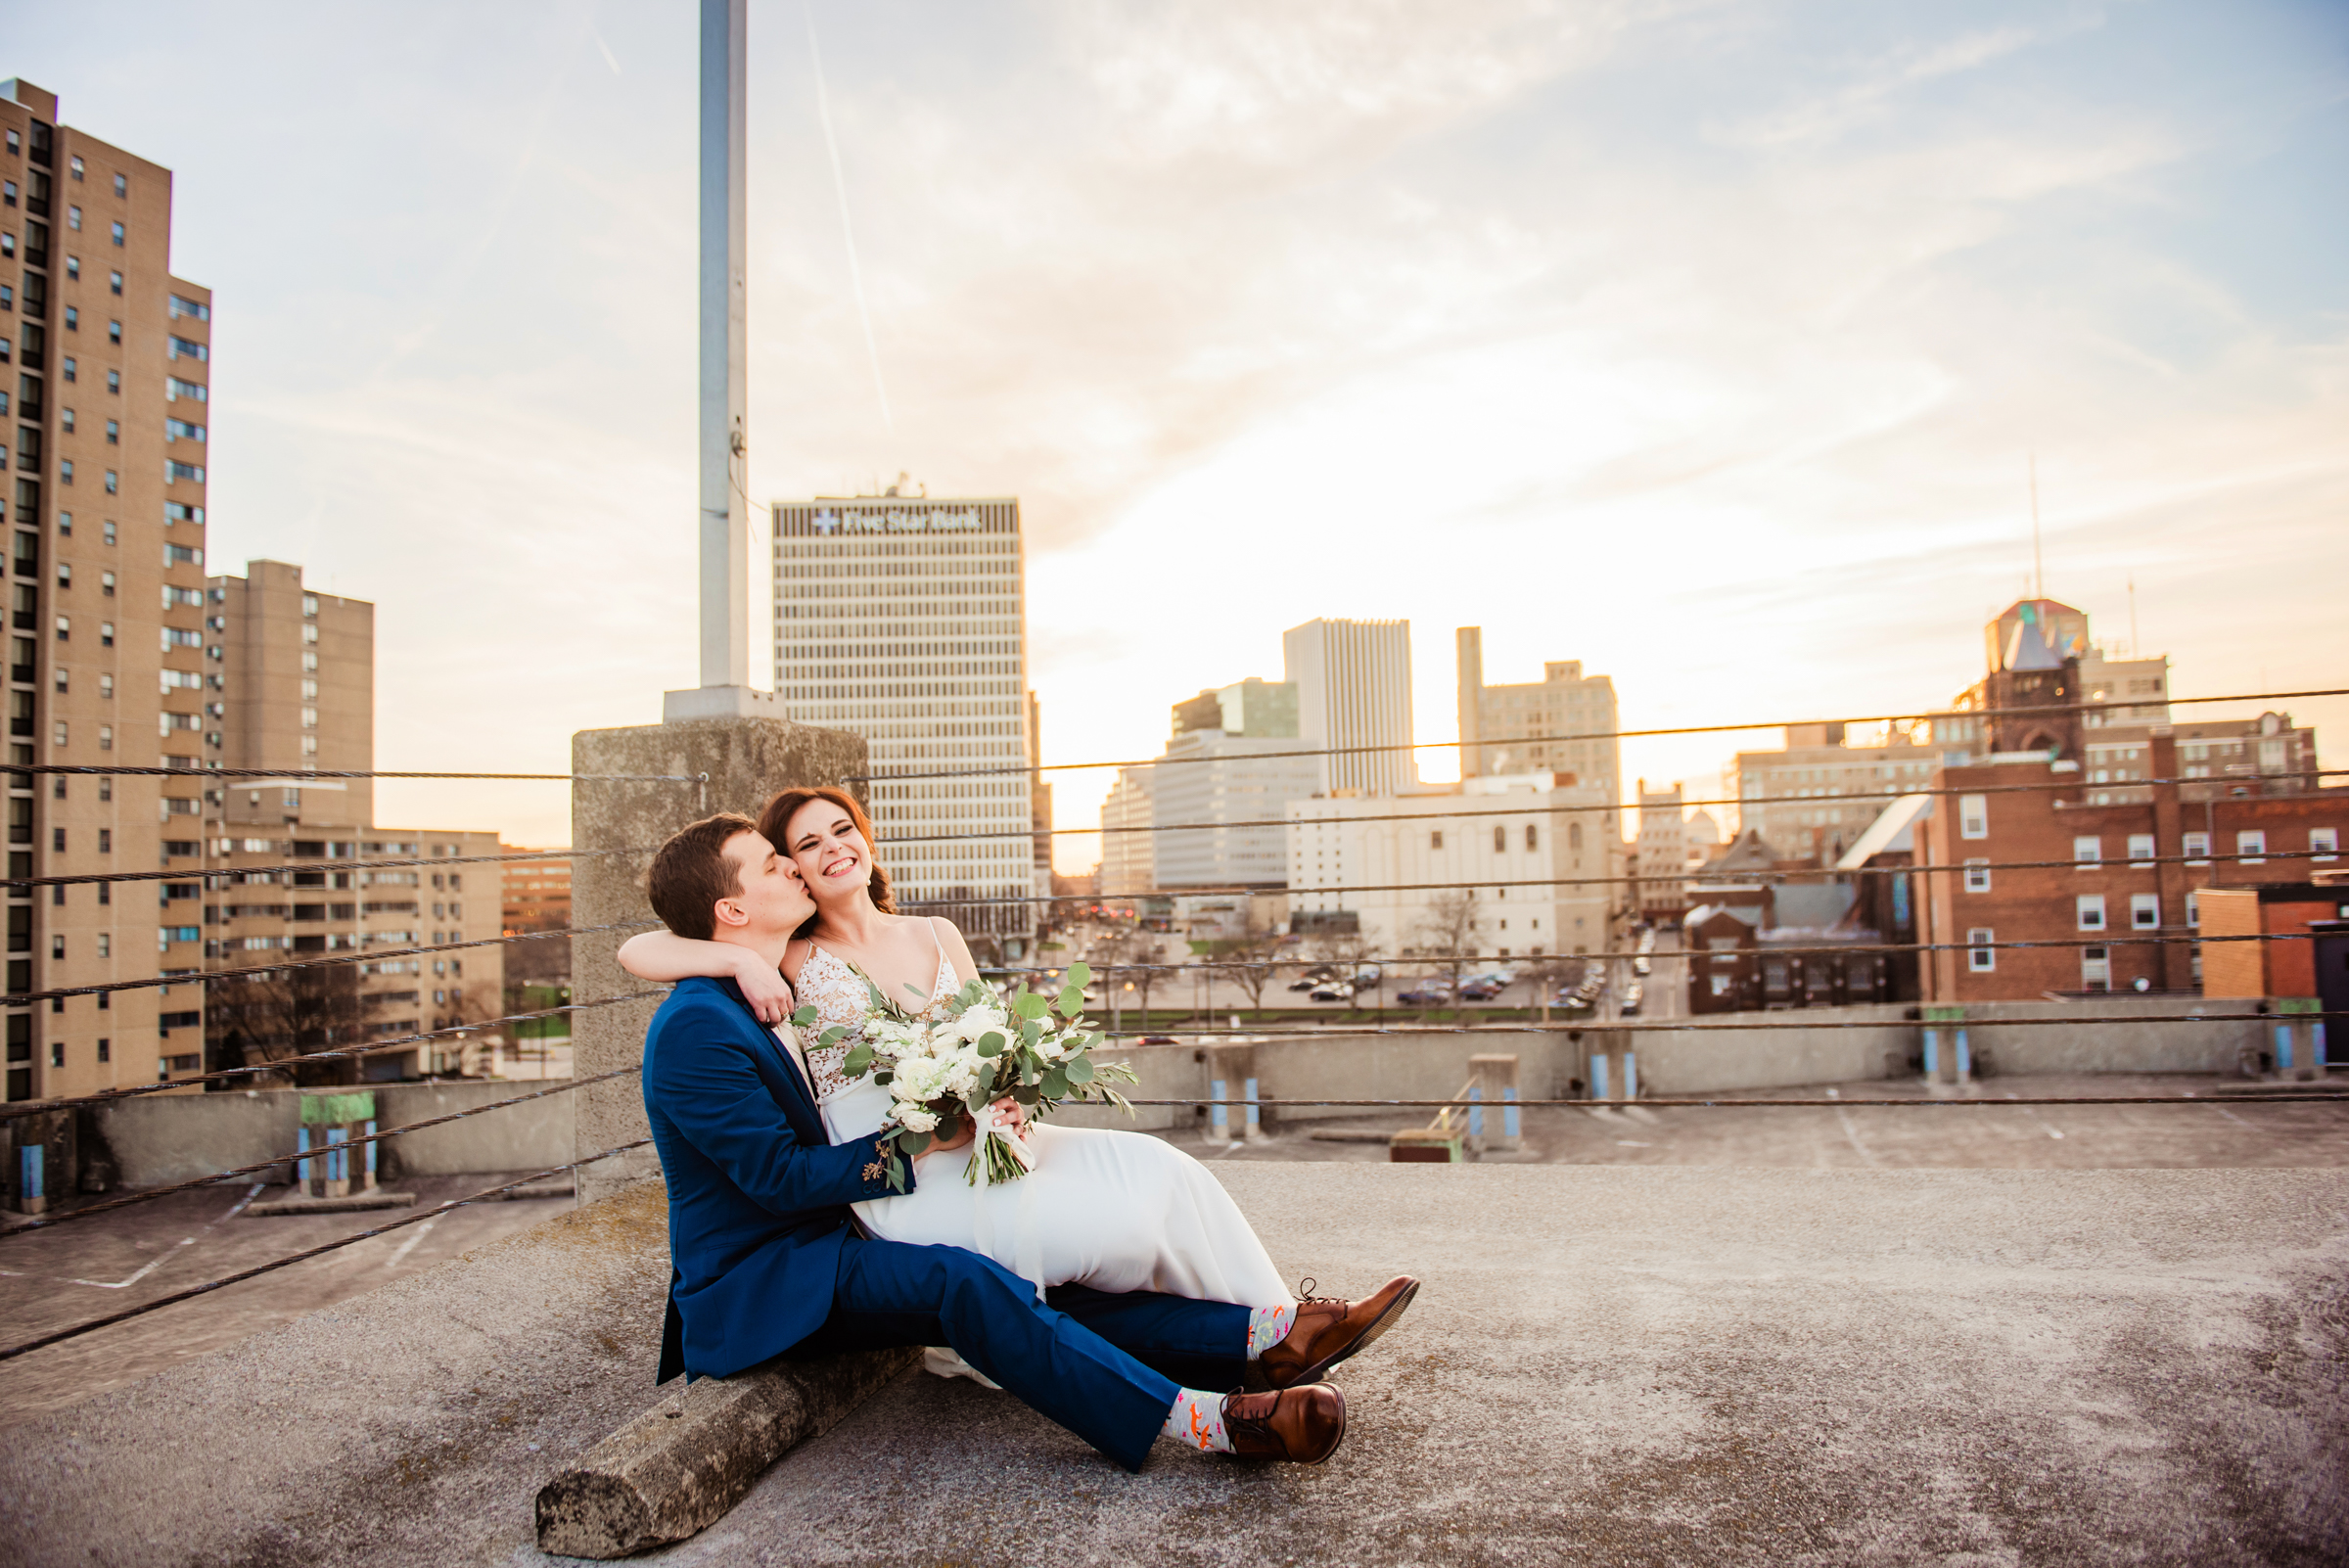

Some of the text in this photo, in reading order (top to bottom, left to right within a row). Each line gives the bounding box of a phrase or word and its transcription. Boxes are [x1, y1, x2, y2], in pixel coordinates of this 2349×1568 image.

[843, 508, 982, 531] Five Star Bank
